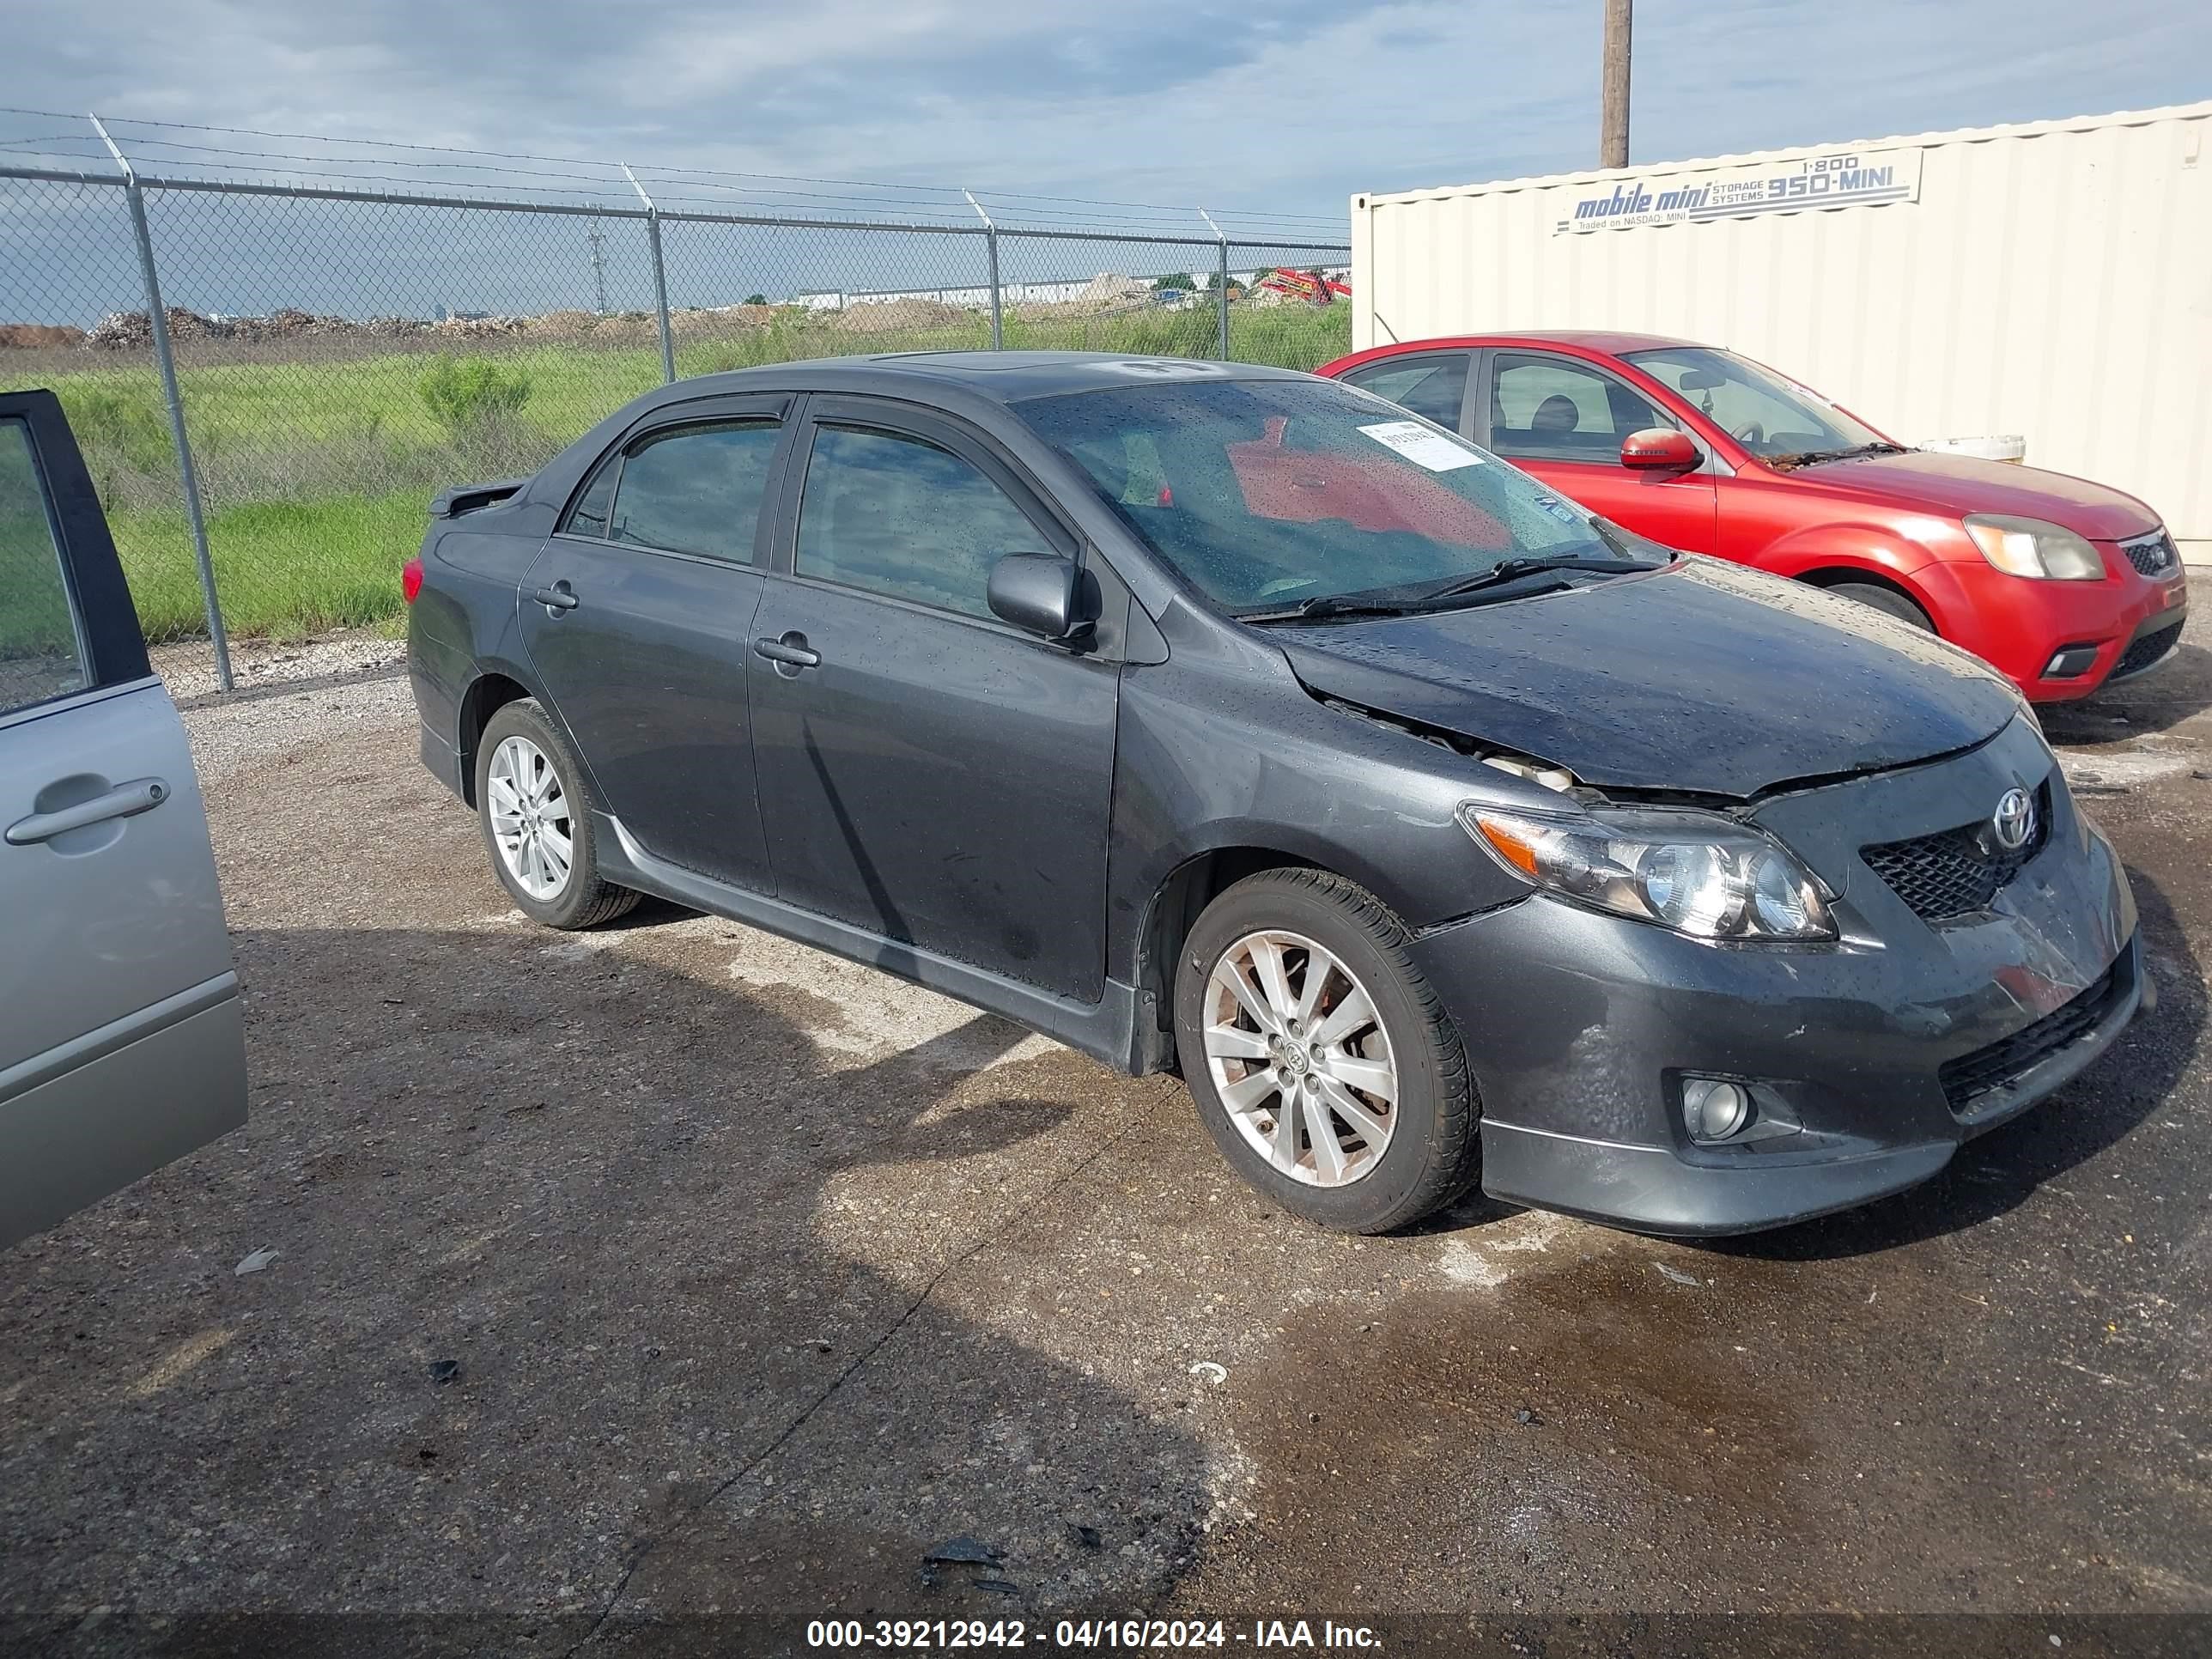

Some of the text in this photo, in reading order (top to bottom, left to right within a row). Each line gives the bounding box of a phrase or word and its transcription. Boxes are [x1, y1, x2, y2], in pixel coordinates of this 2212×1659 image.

[1712, 180, 1764, 194] STORAGE
[1768, 166, 1893, 198] 950-MINI
[1574, 182, 1712, 220] mobile mini
[1712, 191, 1764, 204] SYSTEMS
[1579, 220, 1607, 229] Traded
[1624, 215, 1663, 226] NASDAQ:
[1667, 212, 1686, 222] MINI
